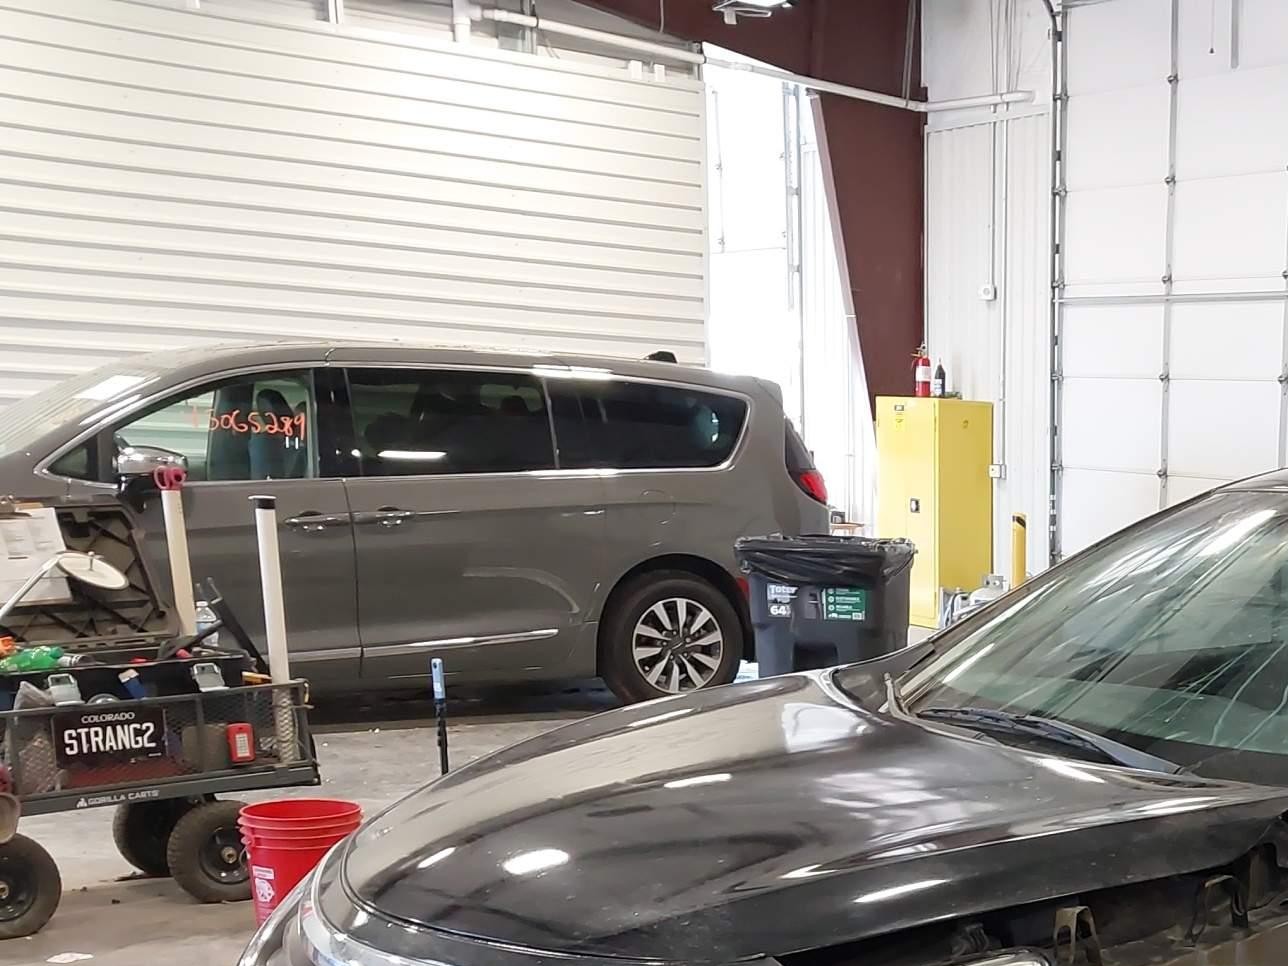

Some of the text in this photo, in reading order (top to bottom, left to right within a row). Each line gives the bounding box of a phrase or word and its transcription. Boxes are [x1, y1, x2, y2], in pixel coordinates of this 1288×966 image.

[770, 605, 786, 615] 64
[81, 712, 135, 724] COLORADO
[64, 723, 156, 755] STRANG2
[87, 790, 159, 805] GORILLA CARTS
